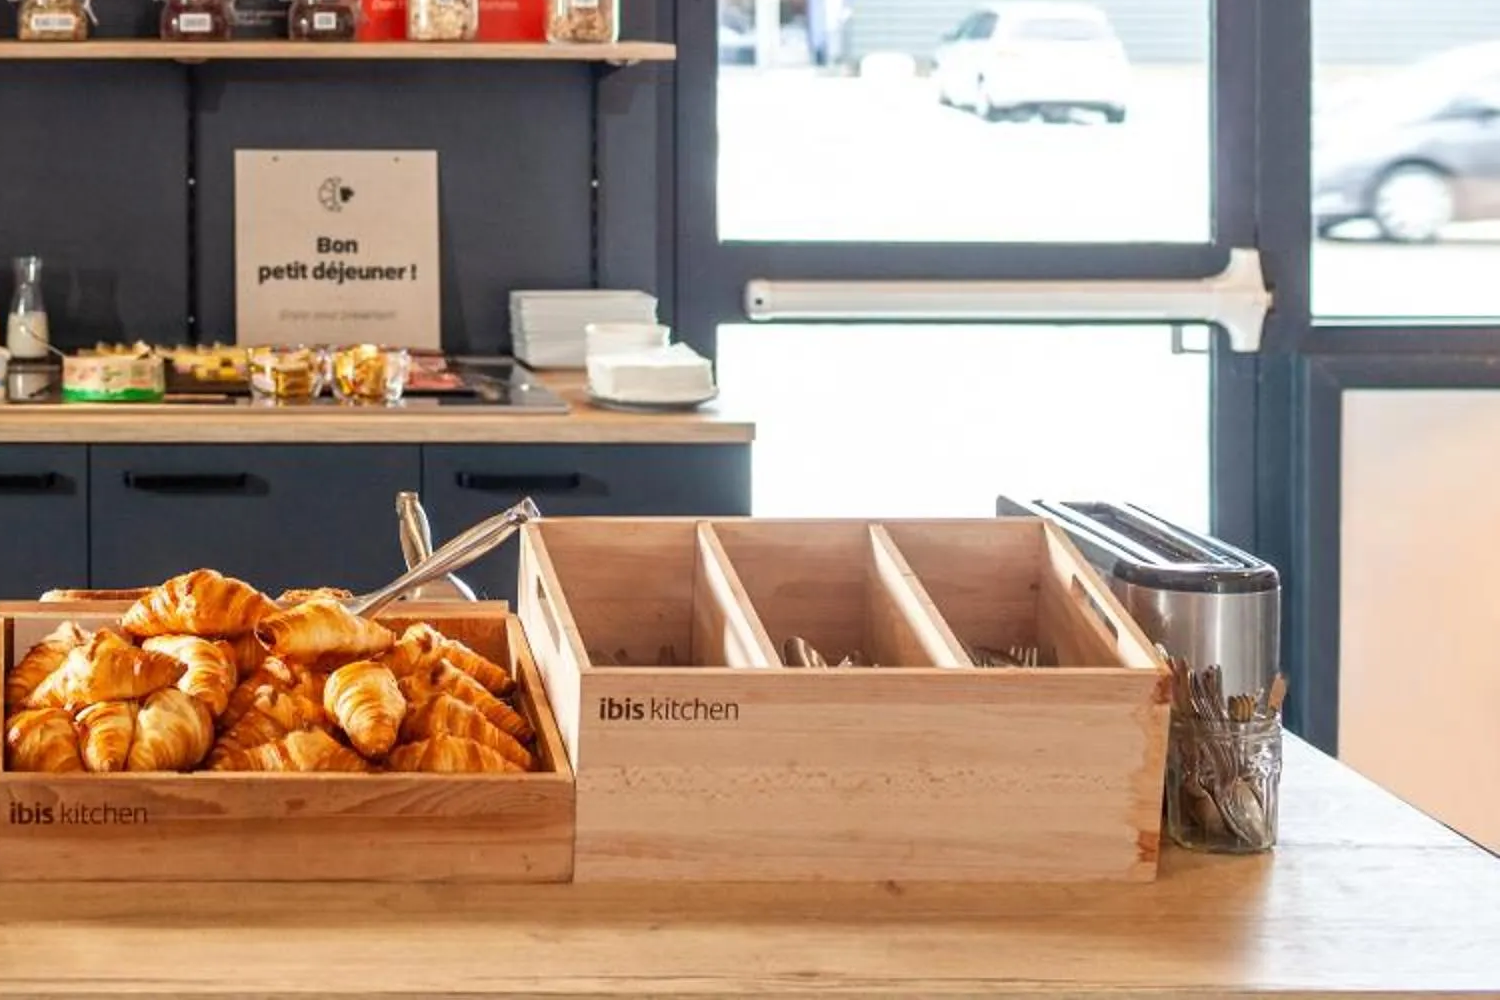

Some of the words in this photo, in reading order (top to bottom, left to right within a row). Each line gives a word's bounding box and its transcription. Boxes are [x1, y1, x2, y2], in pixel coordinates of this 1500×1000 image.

[316, 236, 359, 254] Bon
[258, 261, 308, 285] petit
[312, 261, 407, 285] déjeuner
[599, 697, 645, 721] ibis
[650, 697, 739, 721] kitchen
[9, 801, 55, 825] ibis
[59, 801, 148, 825] kitchen
